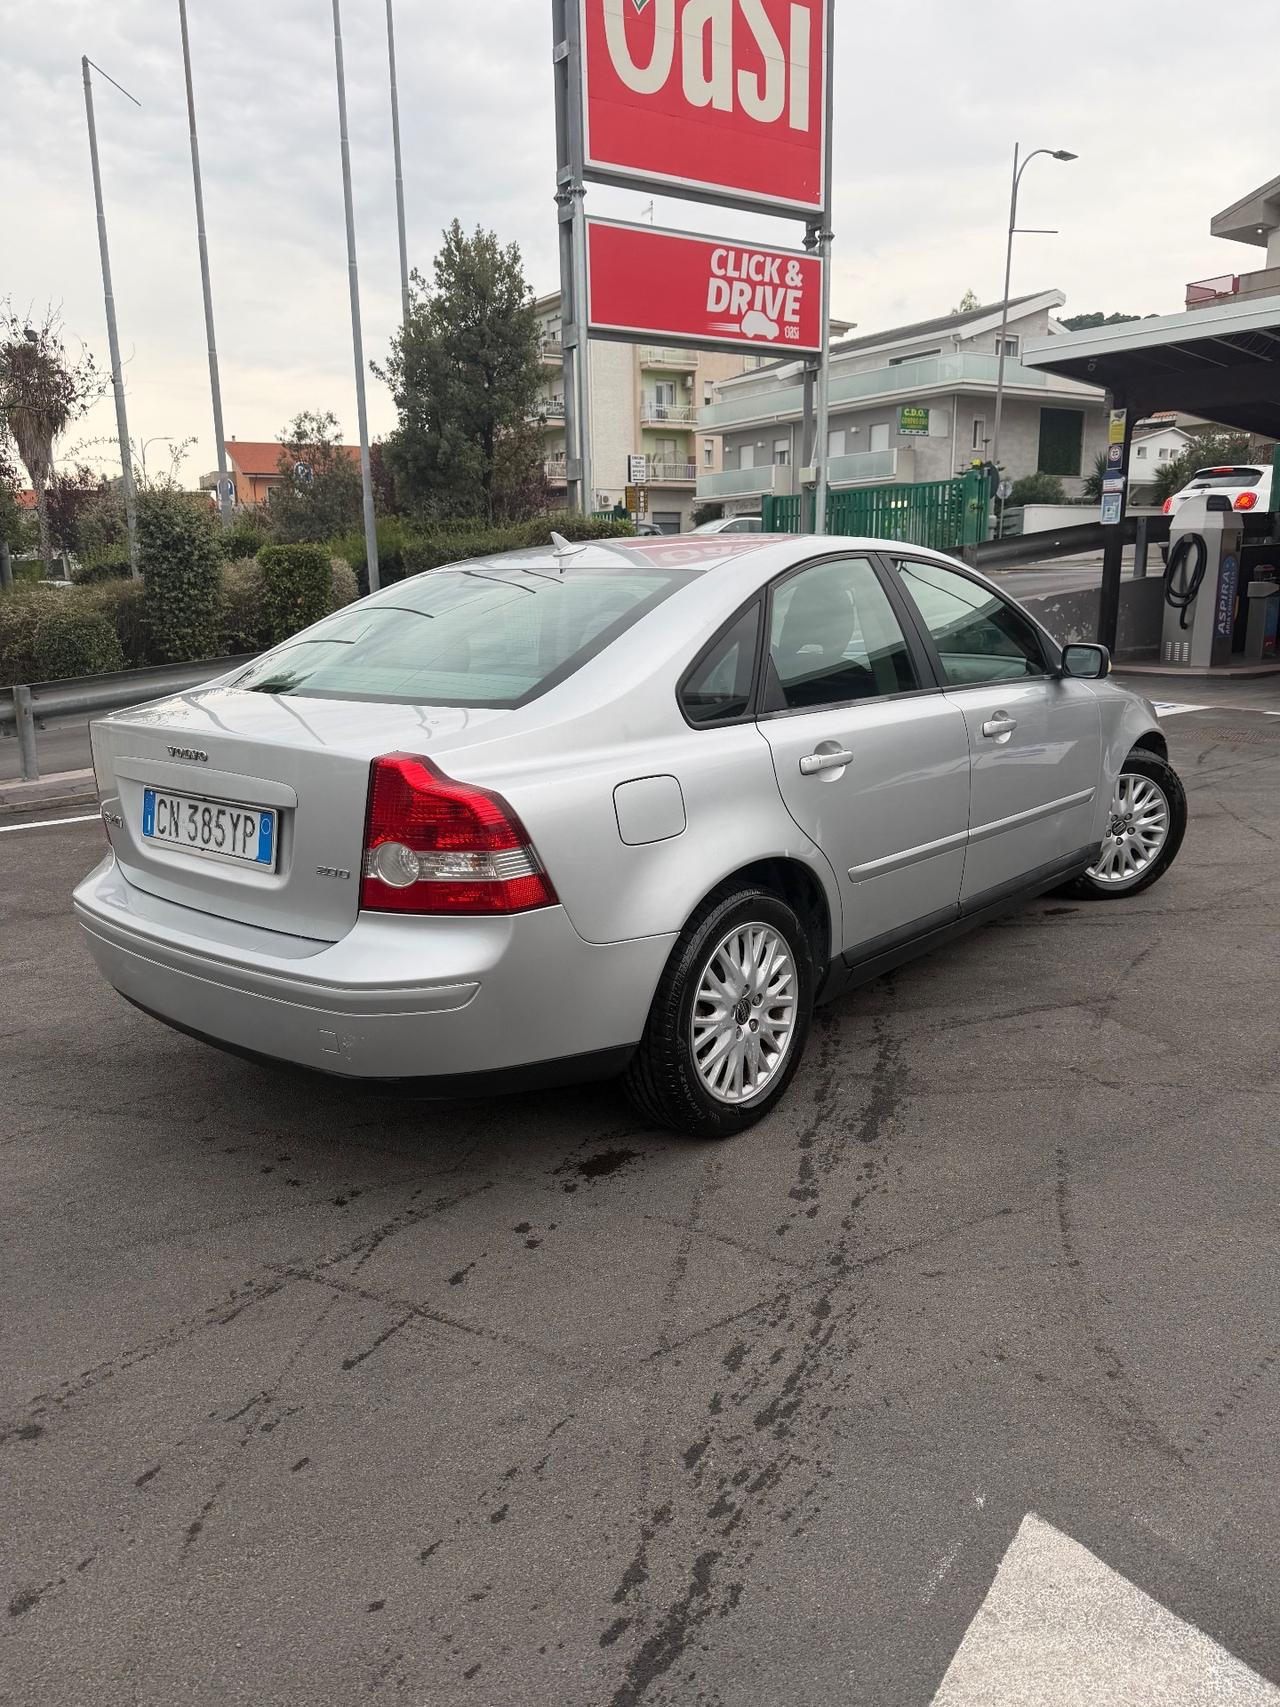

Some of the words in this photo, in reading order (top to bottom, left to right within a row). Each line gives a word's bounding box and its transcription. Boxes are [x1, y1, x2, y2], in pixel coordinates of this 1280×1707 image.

[710, 248, 783, 284] CLICK
[785, 260, 803, 287] &
[706, 276, 803, 323] DRIVE
[1218, 571, 1231, 634] ASPIRA
[166, 745, 208, 762] VOLVO
[157, 798, 181, 838] CN
[188, 804, 256, 854] 385YP
